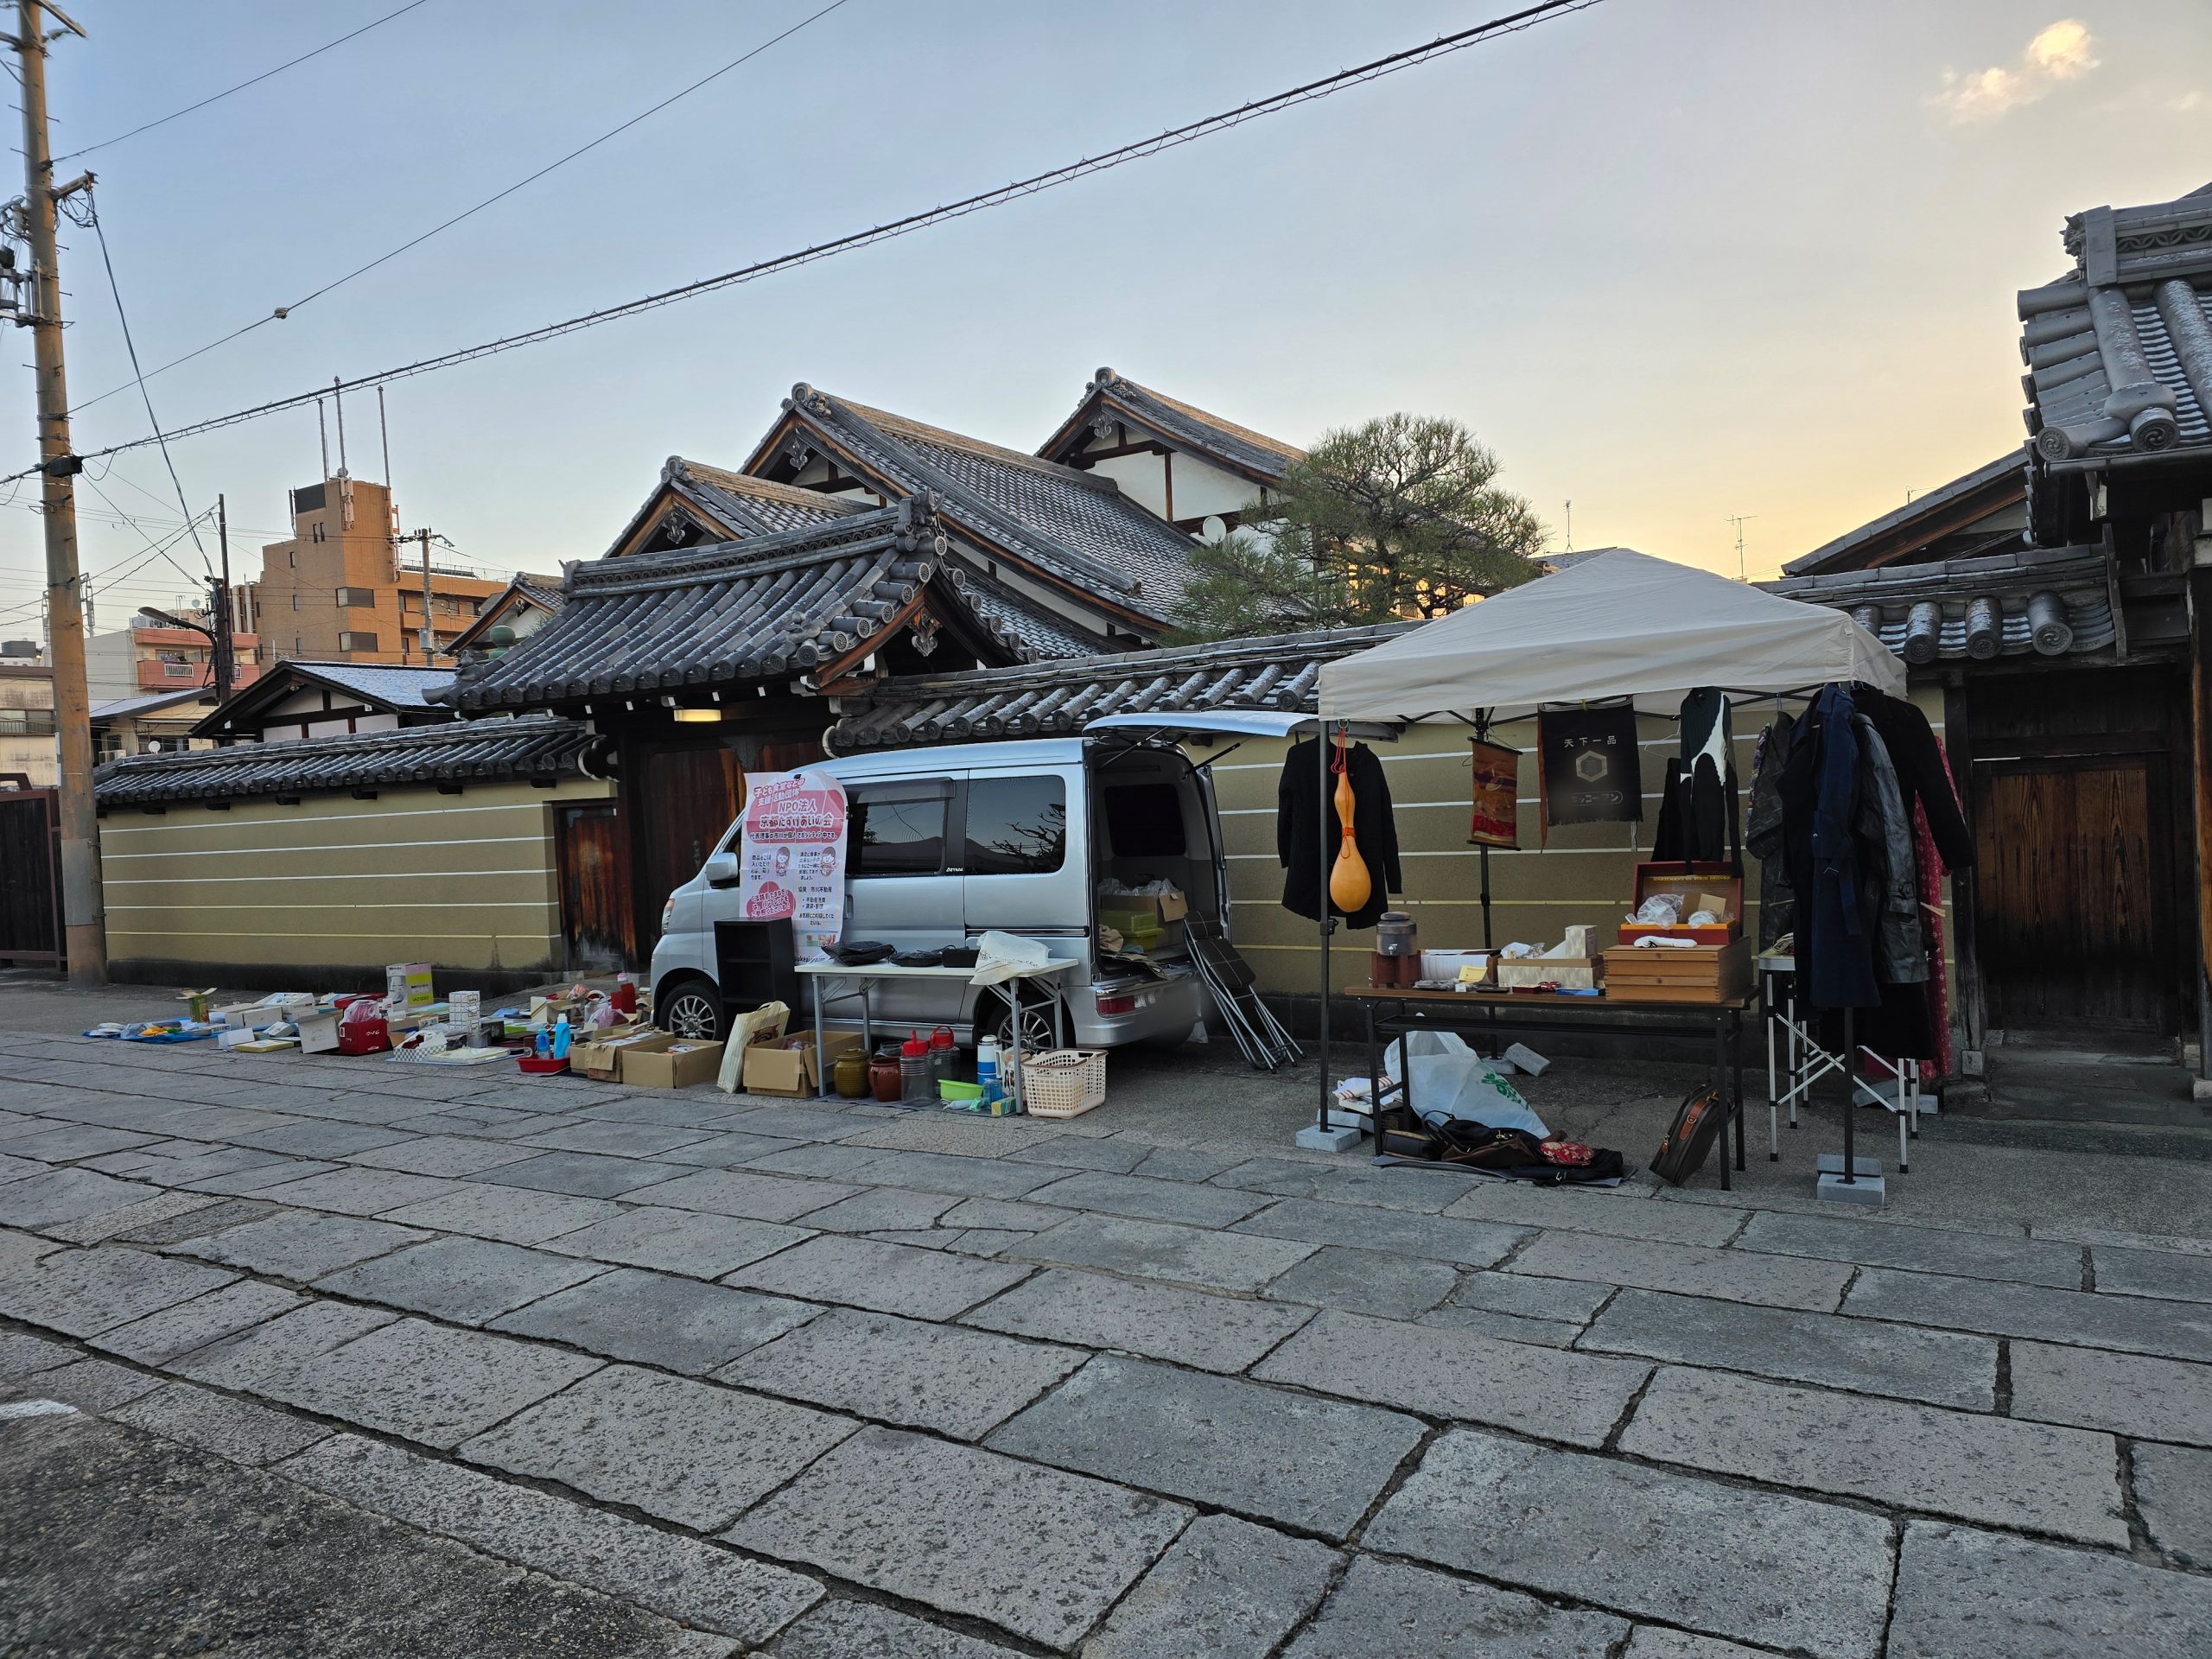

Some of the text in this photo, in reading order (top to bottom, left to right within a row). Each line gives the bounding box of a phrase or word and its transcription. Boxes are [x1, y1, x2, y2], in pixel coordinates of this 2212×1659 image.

[1564, 735, 1617, 748] 天下一品
[779, 799, 817, 812] NPO法人
[760, 813, 833, 828] 京都たすけあいの会
